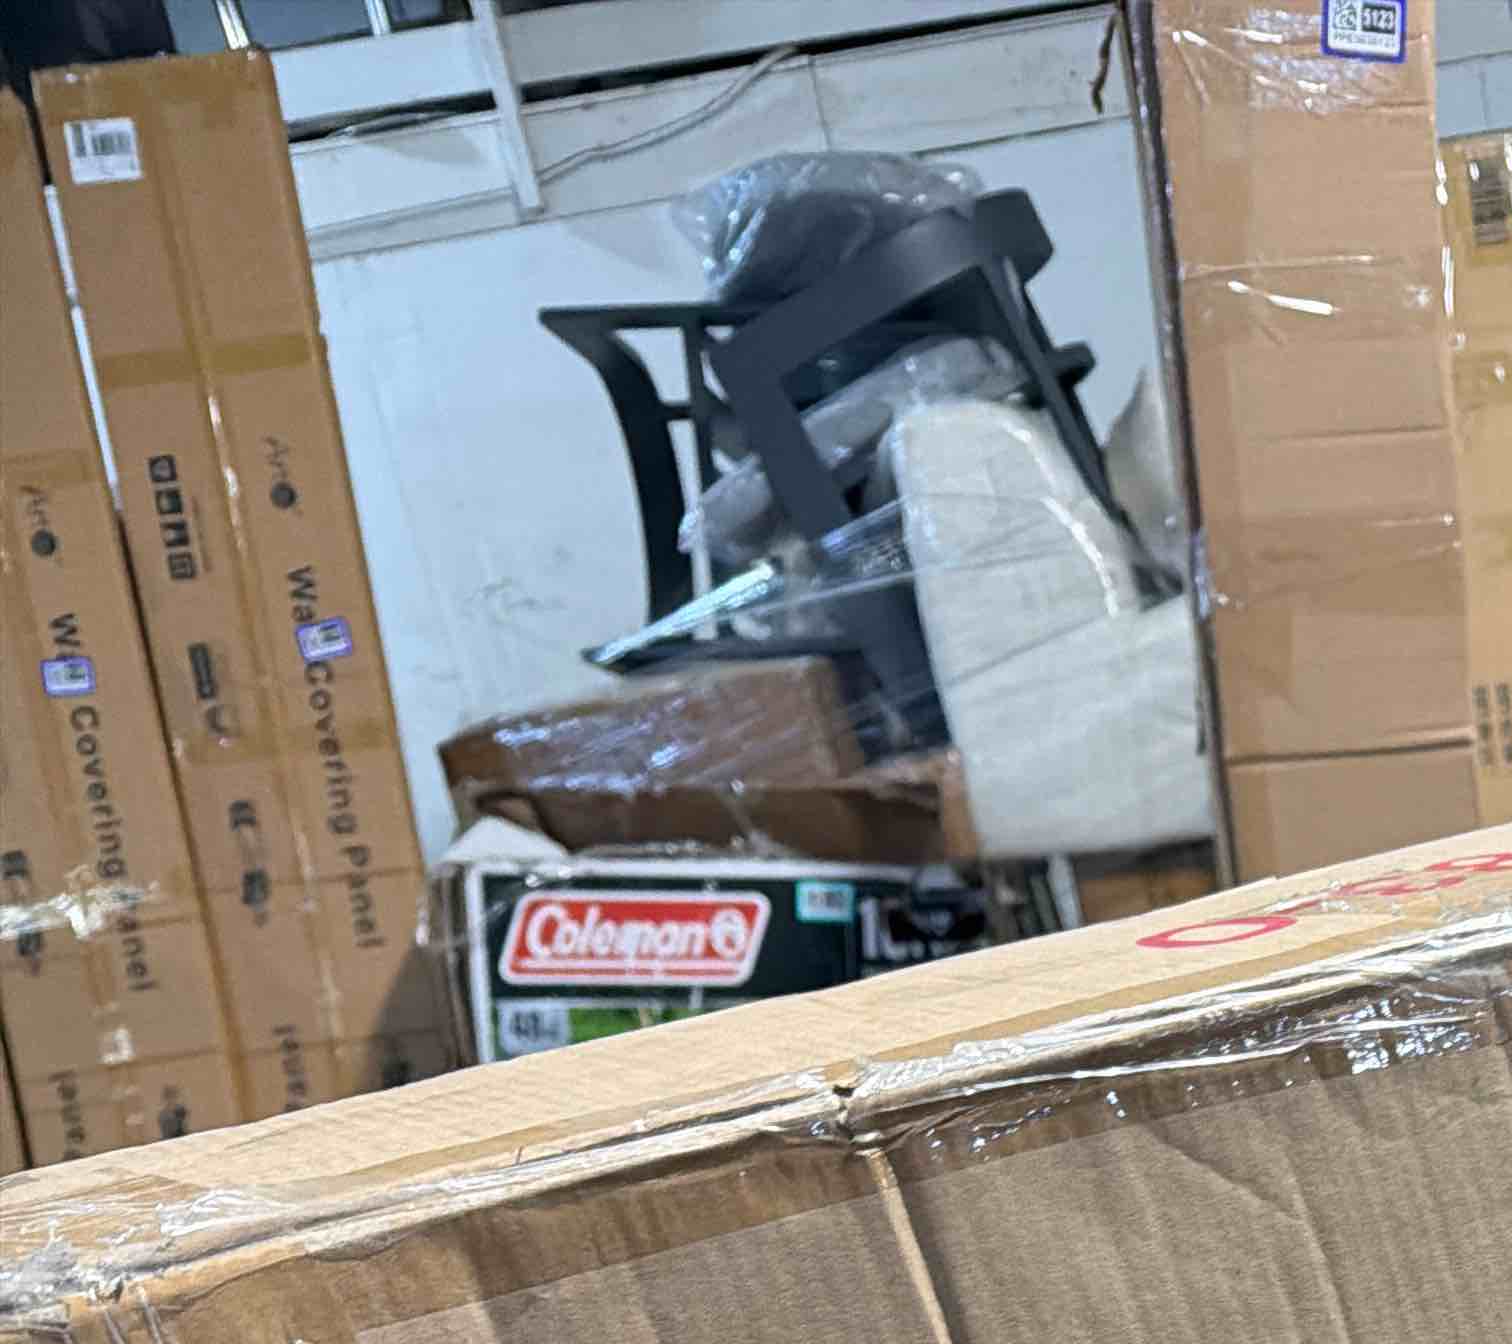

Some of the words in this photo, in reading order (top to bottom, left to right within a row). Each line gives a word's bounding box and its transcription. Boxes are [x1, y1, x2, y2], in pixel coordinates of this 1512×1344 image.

[68, 704, 129, 880] Covering
[306, 662, 356, 836] Covering
[341, 845, 386, 949] Panel
[526, 902, 706, 958] Coleman
